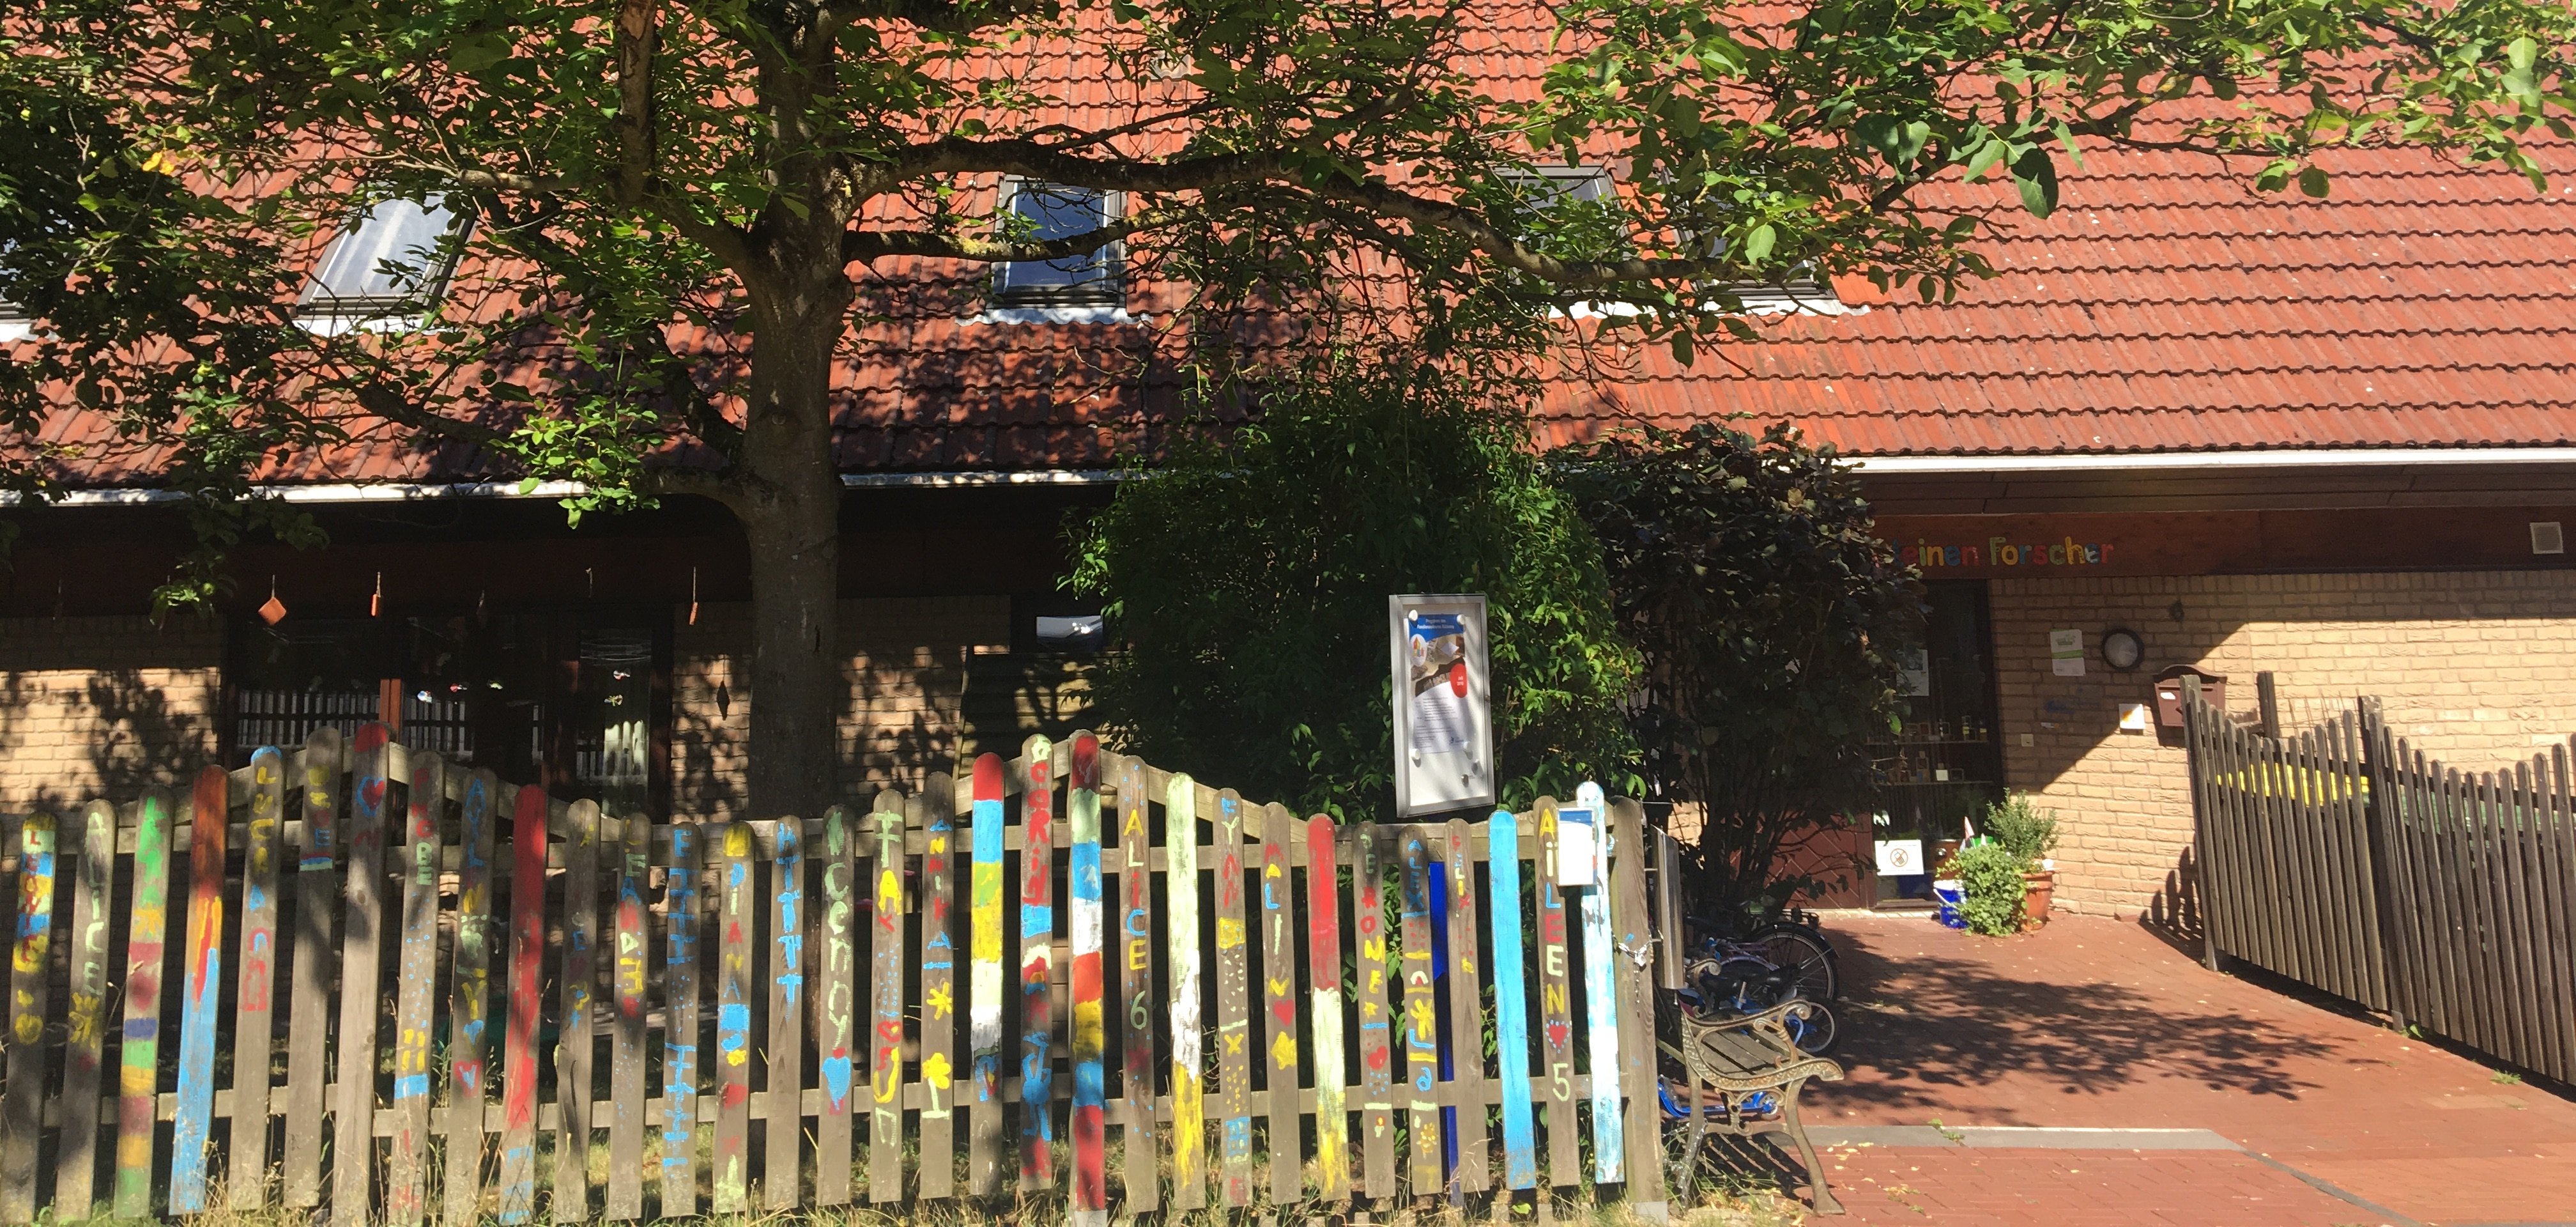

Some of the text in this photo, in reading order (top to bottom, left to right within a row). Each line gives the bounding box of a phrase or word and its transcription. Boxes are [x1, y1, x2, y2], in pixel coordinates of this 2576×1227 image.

[1892, 536, 2114, 567] leinen Forscher
[1407, 839, 1424, 911] ALEX
[84, 812, 107, 996] ALICE
[723, 863, 746, 1001] DIANA
[1130, 991, 1147, 1030] 6
[1552, 1063, 1570, 1102] 5
